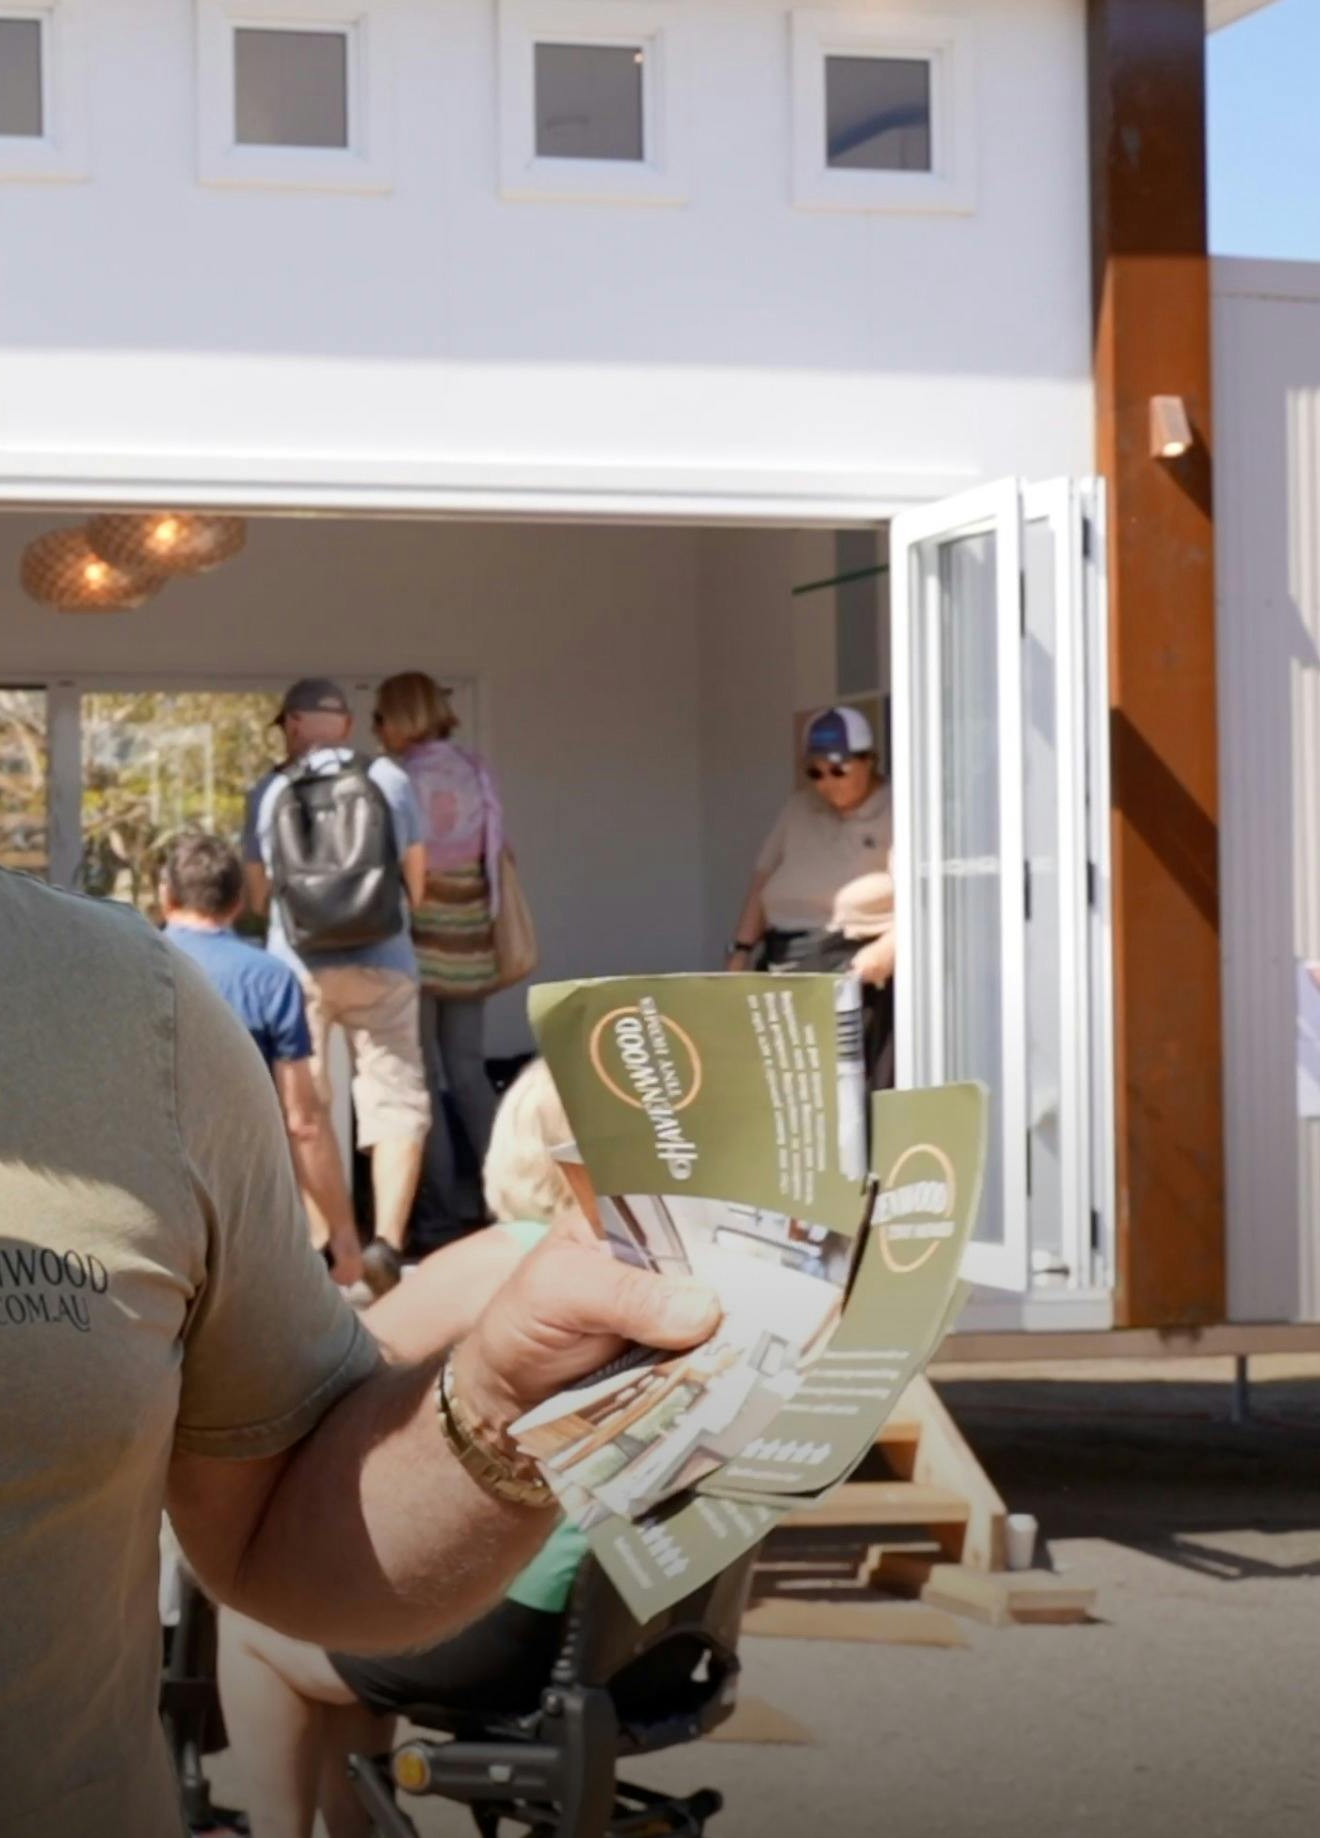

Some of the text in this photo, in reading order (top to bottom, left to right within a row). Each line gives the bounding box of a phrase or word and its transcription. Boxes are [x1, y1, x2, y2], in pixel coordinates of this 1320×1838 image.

[614, 1016, 698, 1180] HAVENWOOD
[639, 996, 683, 1096] TINY HOMES
